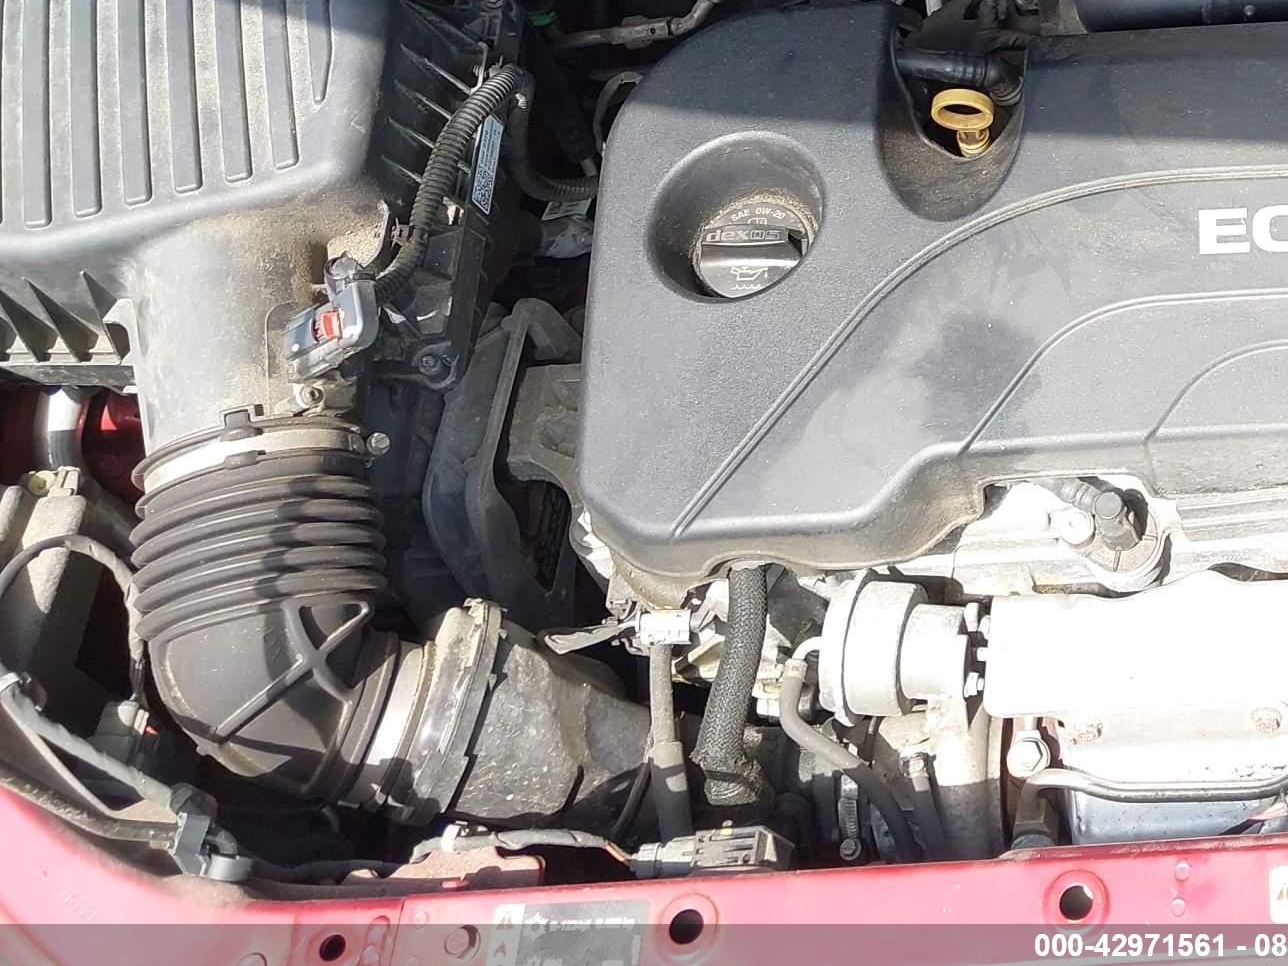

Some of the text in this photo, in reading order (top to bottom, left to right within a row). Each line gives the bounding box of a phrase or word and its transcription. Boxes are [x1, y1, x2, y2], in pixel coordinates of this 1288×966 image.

[731, 209, 751, 222] SAE
[755, 207, 786, 220] 0W-20
[706, 229, 781, 242] dexos
